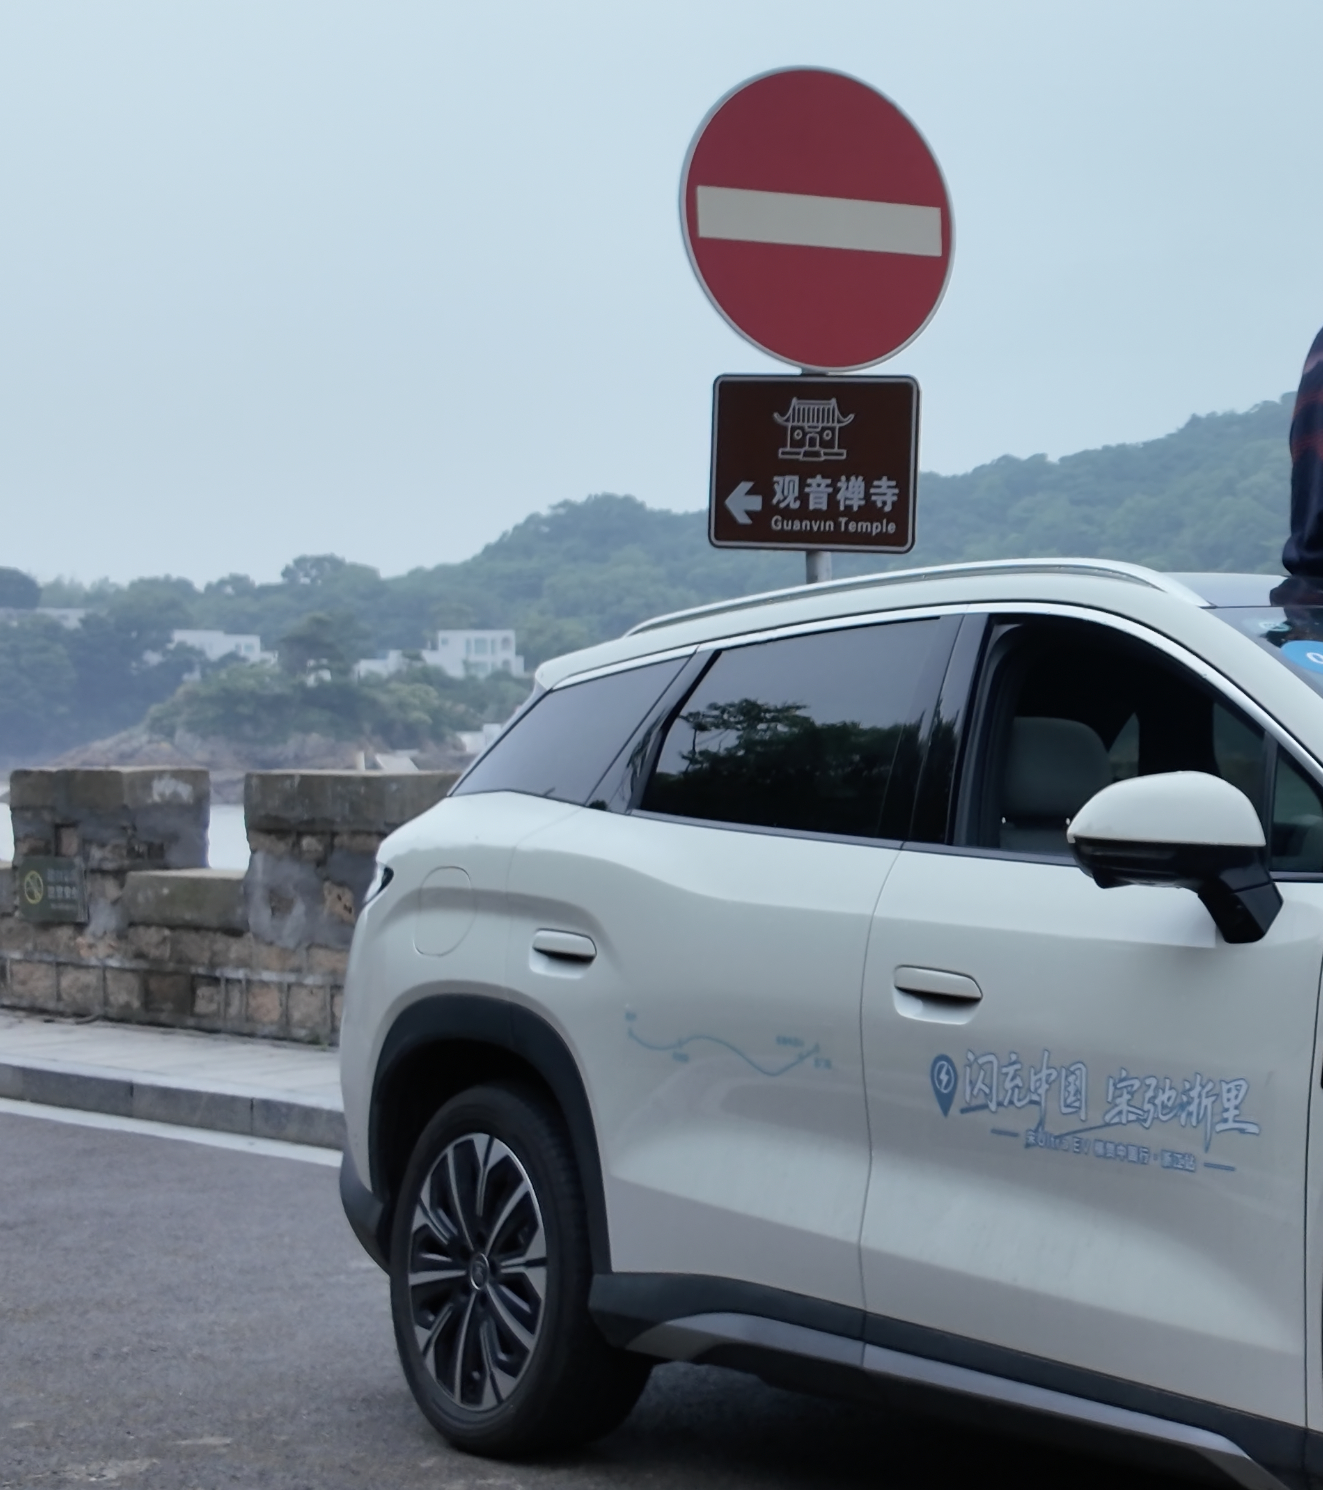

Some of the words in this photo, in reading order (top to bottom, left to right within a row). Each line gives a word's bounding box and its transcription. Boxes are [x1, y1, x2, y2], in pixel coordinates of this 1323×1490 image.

[771, 474, 900, 513] 观音禅寺
[838, 517, 897, 537] Temple
[963, 1049, 1088, 1124] 闪充中国
